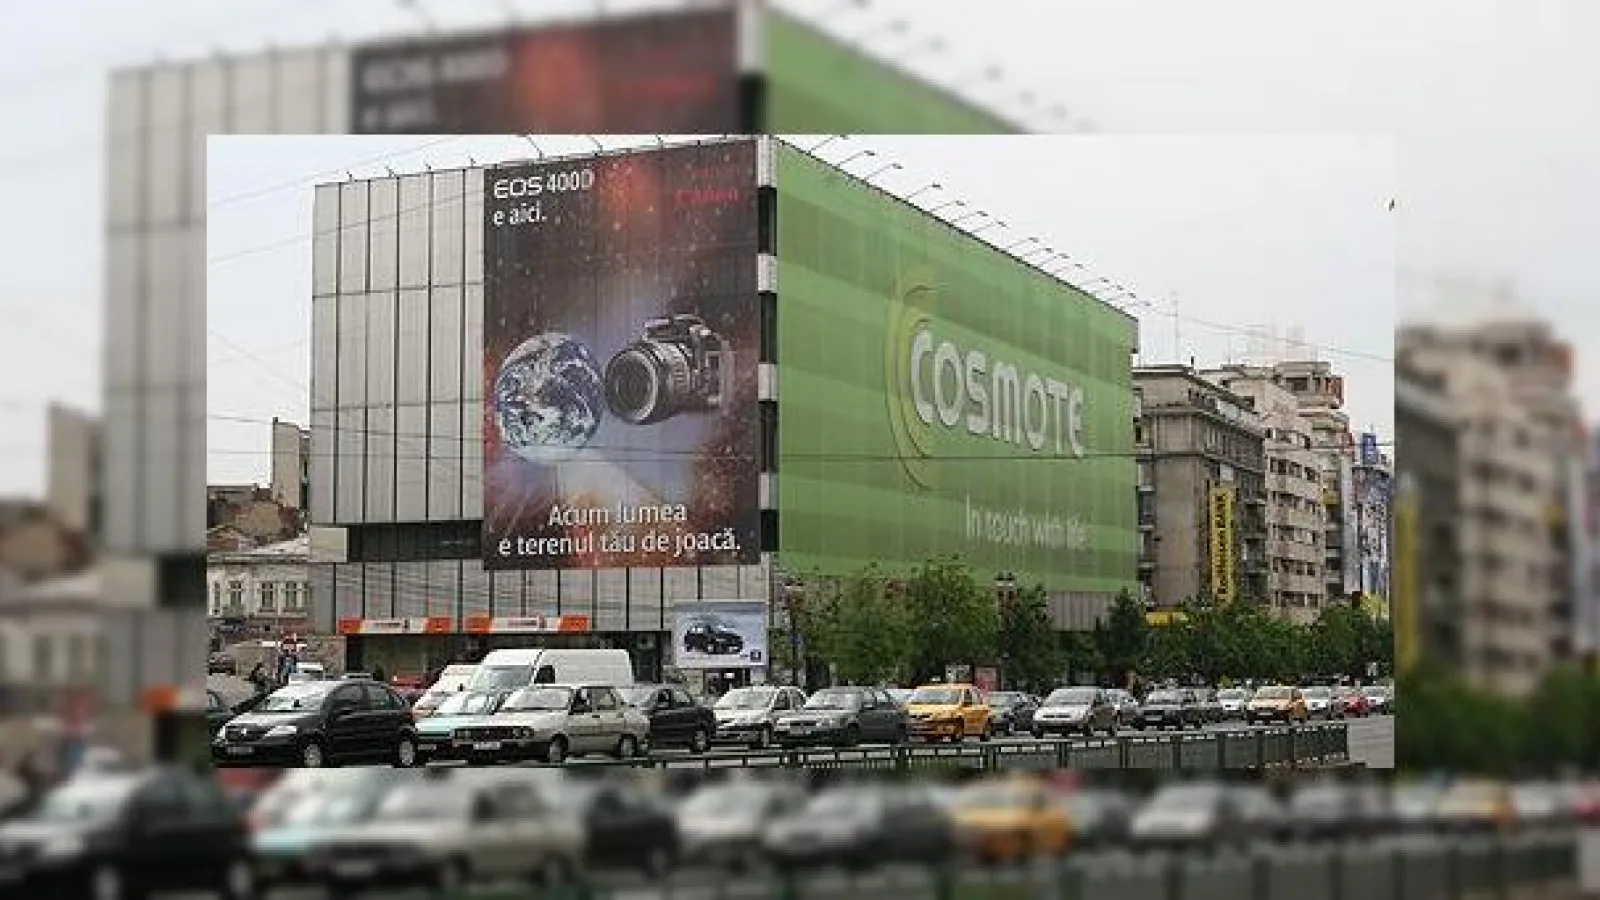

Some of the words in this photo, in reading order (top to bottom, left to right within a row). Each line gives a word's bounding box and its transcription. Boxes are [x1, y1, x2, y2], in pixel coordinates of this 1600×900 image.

[493, 175, 543, 199] EOS
[546, 168, 595, 193] 400D
[493, 210, 503, 226] e
[509, 201, 548, 225] aici.
[910, 329, 1085, 459] COSMOTE
[549, 504, 609, 527] Acum
[616, 501, 687, 525] lumea
[499, 537, 511, 555] e
[517, 530, 593, 556] terenul
[641, 529, 669, 552] de
[674, 527, 741, 558] joacă.
